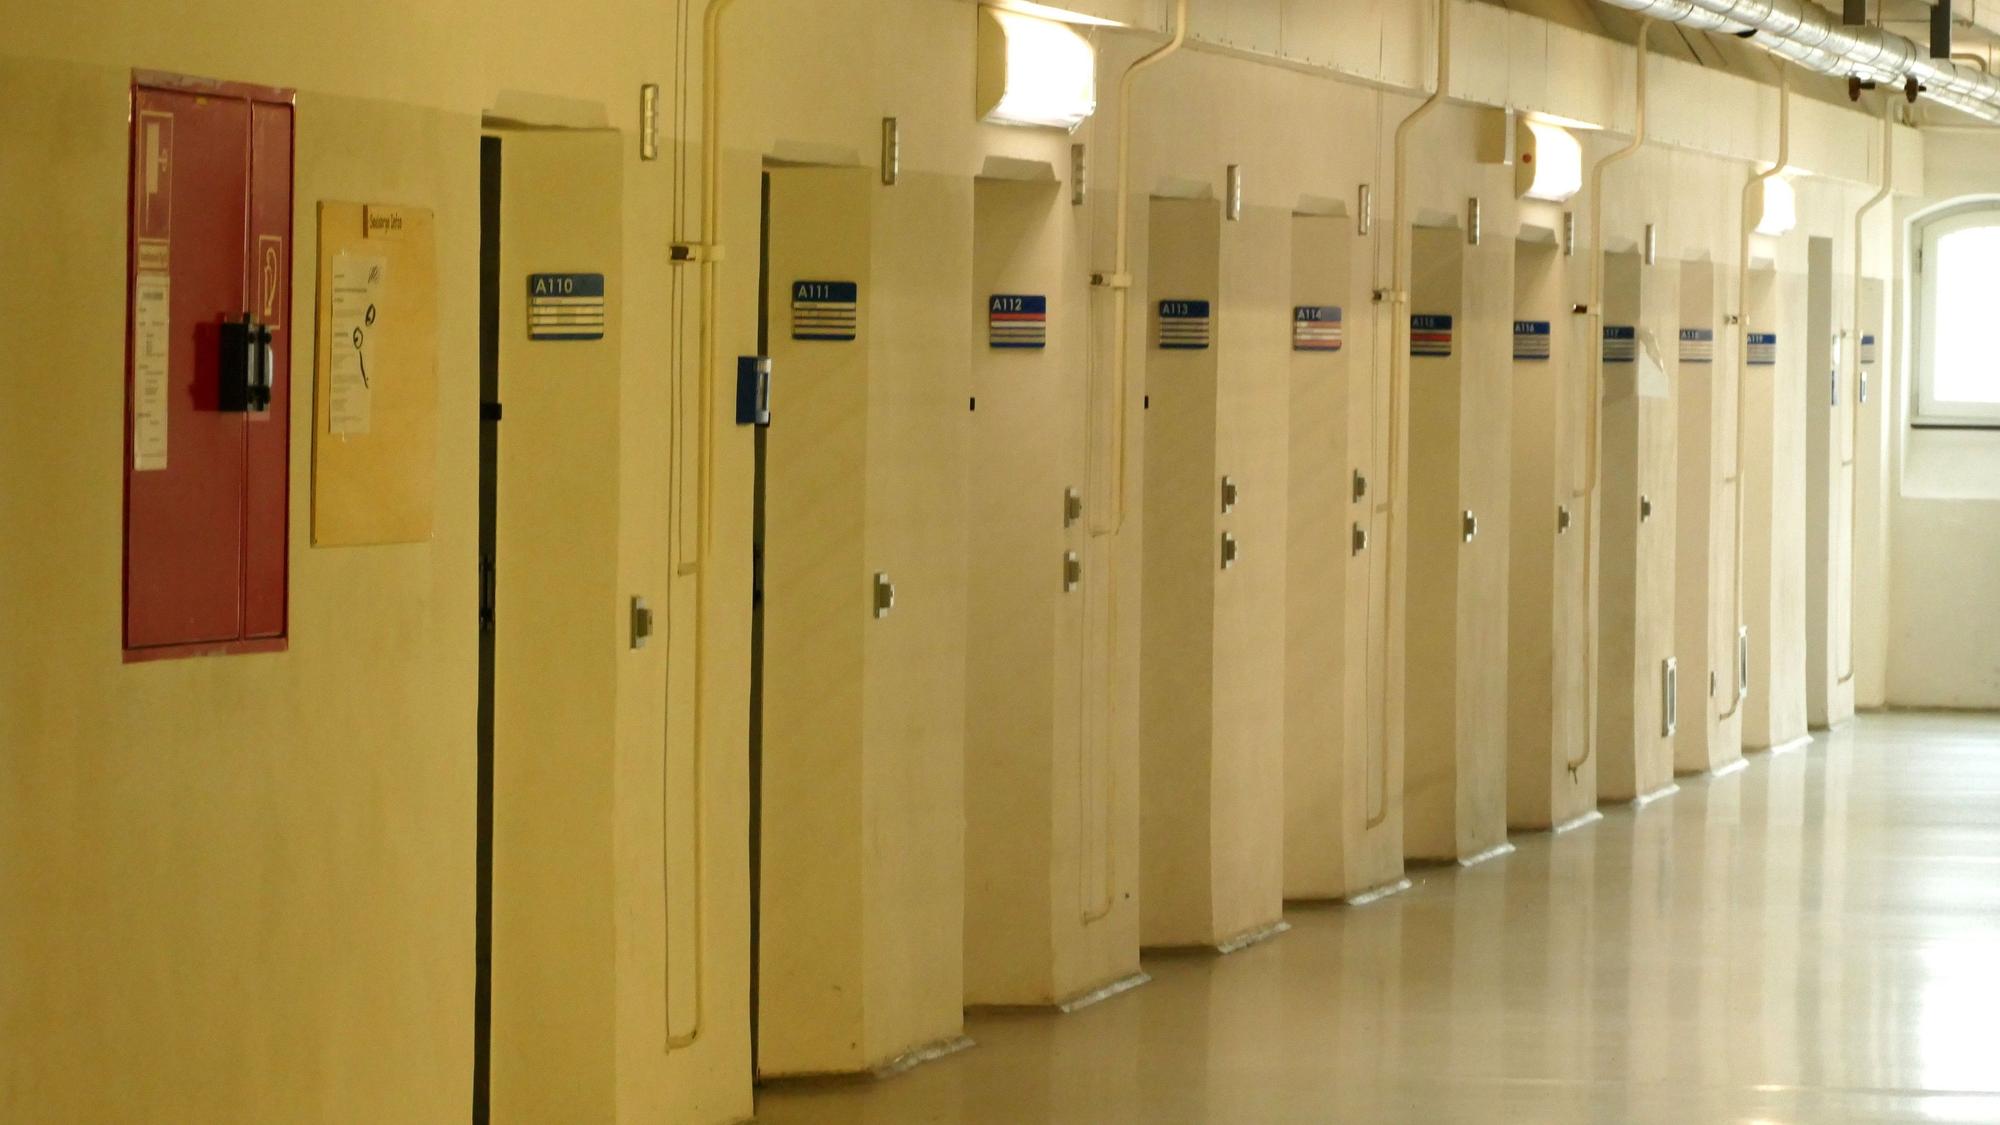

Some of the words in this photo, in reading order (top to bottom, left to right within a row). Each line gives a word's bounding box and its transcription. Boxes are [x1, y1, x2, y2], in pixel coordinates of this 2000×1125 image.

[535, 278, 573, 294] A110
[798, 284, 829, 299] A111
[992, 297, 1022, 312] A112
[1162, 303, 1188, 315] A113
[1297, 308, 1322, 321] A114
